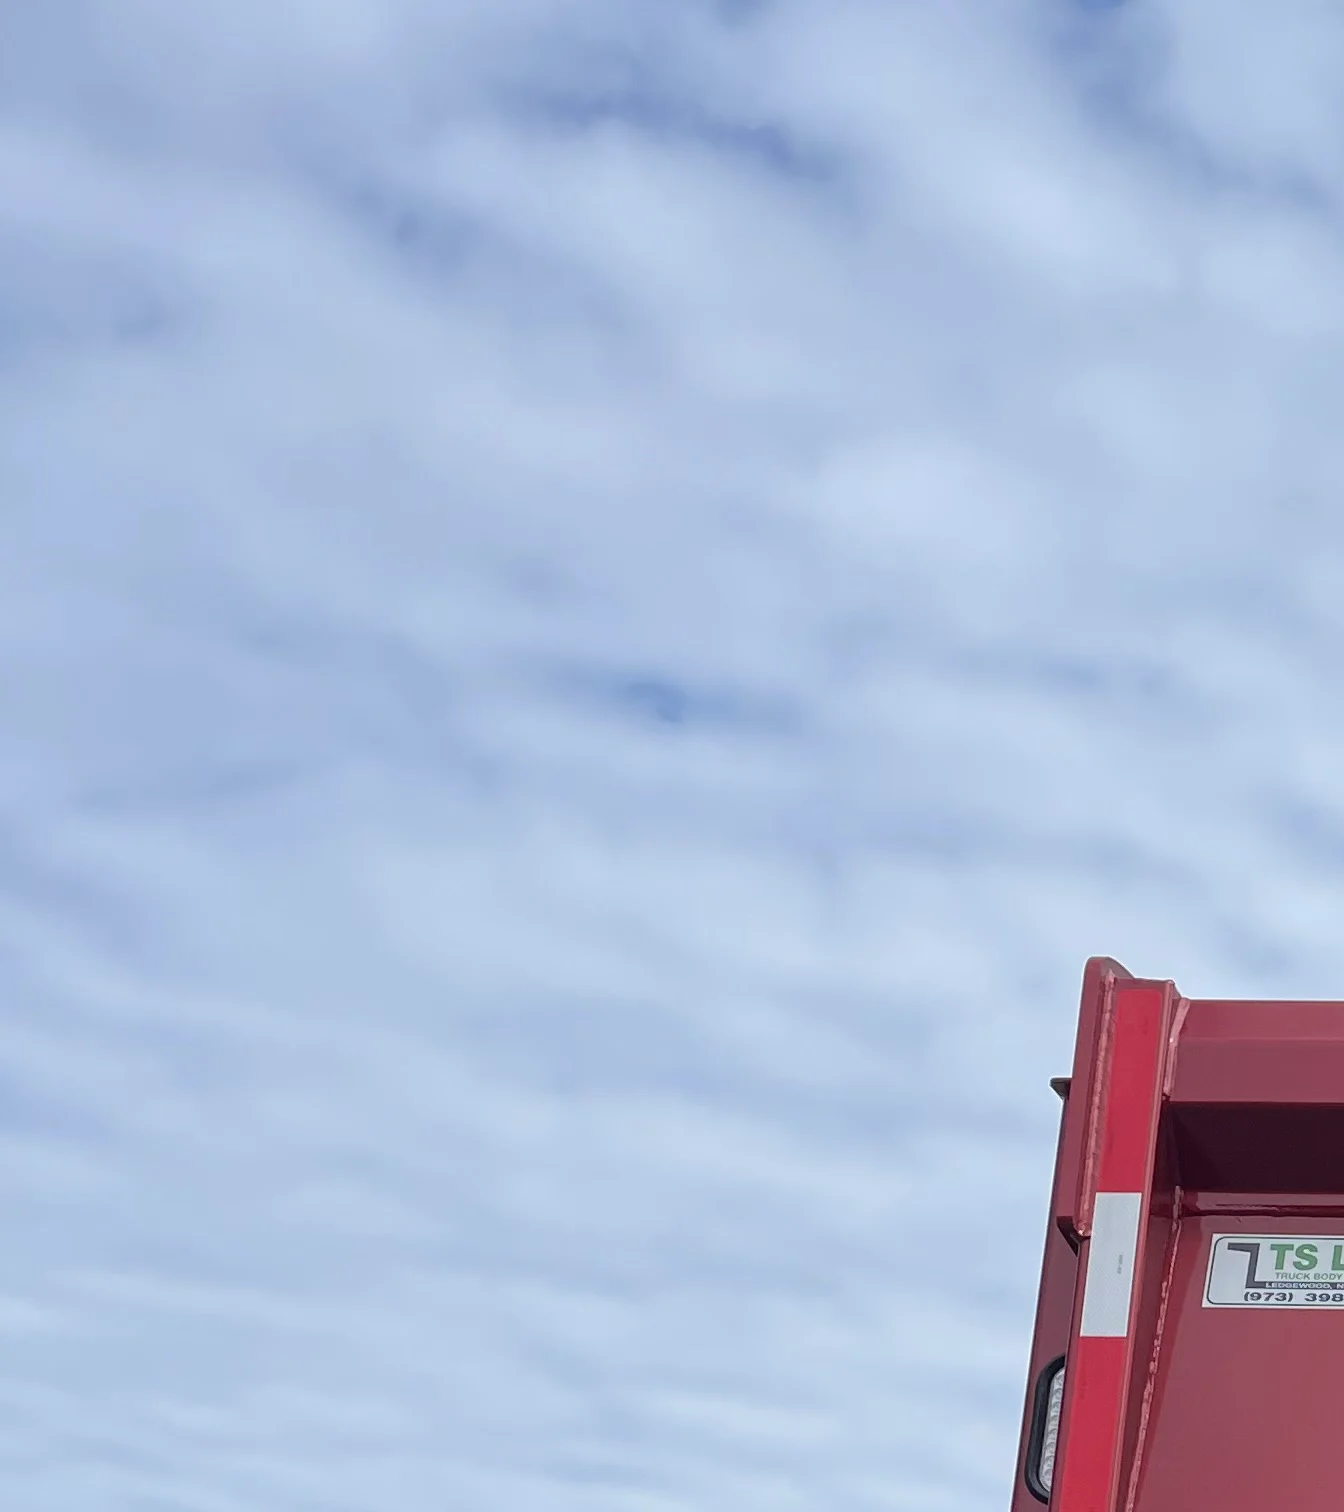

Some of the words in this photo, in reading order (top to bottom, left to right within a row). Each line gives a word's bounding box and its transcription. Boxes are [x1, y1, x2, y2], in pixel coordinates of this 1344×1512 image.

[1275, 1272, 1310, 1280] TRUCK
[1314, 1273, 1343, 1281] BODY
[1243, 1291, 1294, 1303] (973)
